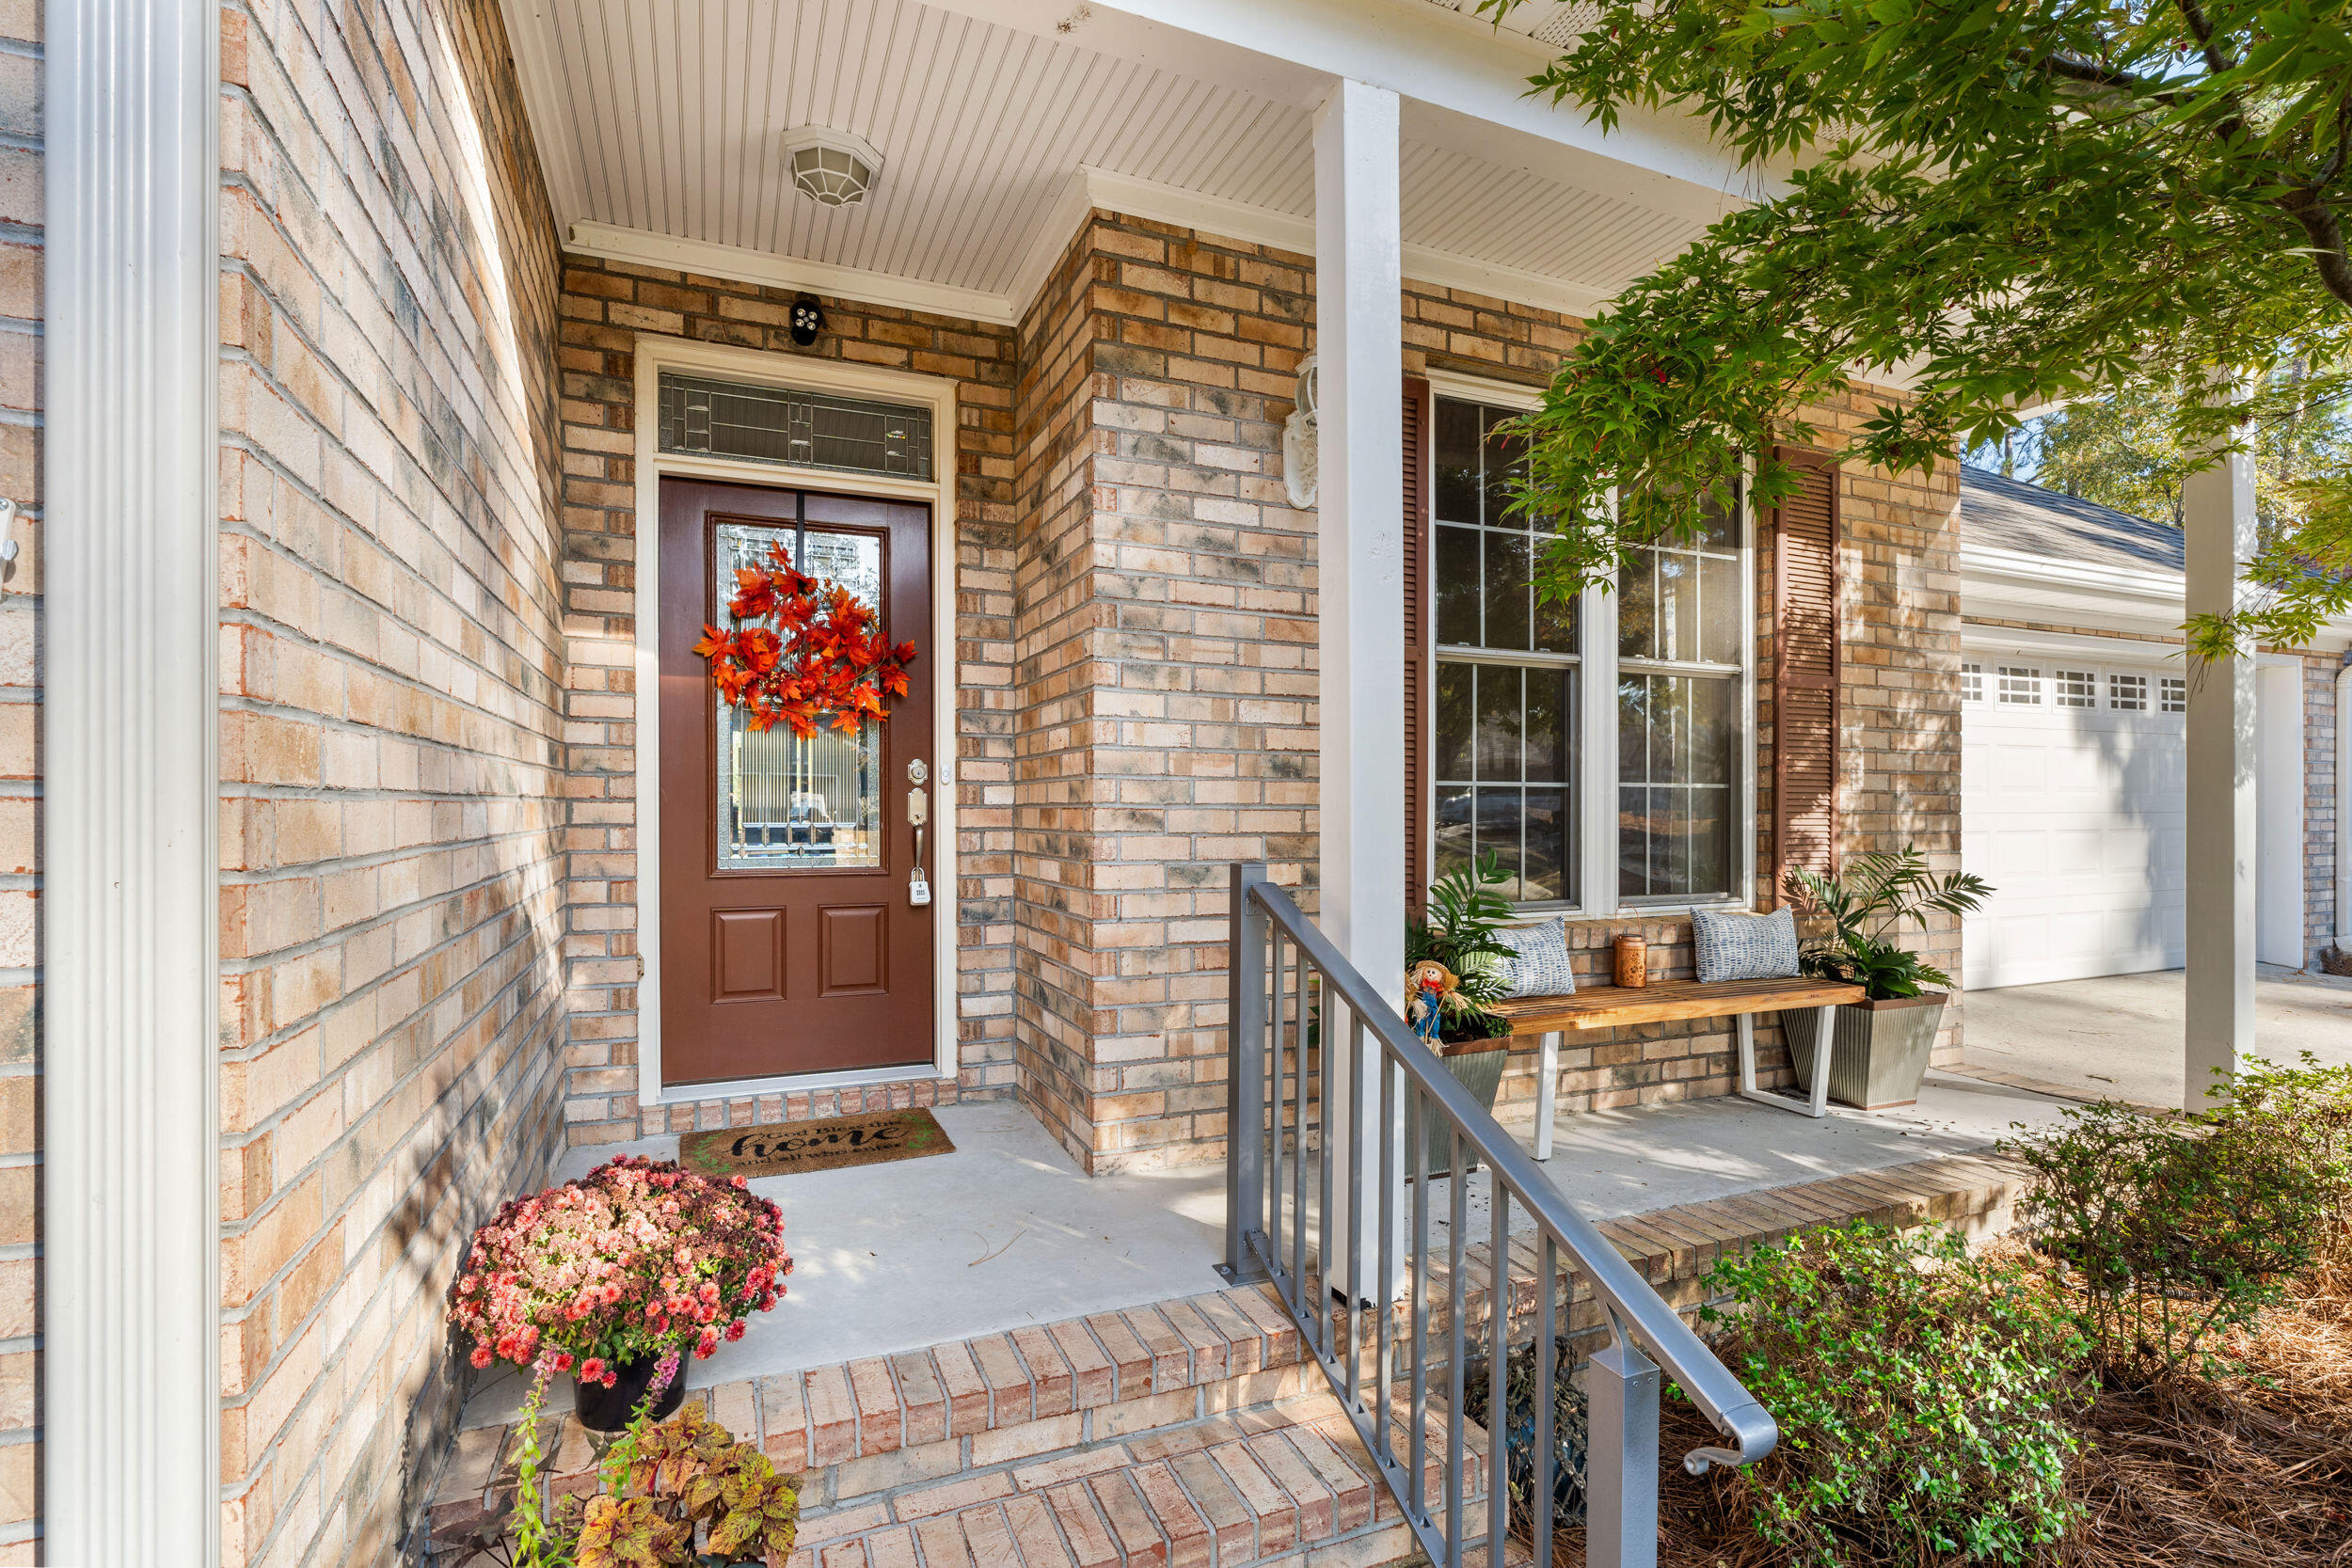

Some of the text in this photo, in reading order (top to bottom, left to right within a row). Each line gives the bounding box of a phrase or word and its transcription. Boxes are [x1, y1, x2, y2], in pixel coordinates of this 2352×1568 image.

[722, 1127, 910, 1157] home
[767, 1130, 807, 1139] God
[816, 1124, 865, 1134] Bless
[737, 1142, 901, 1165] and all who enter
